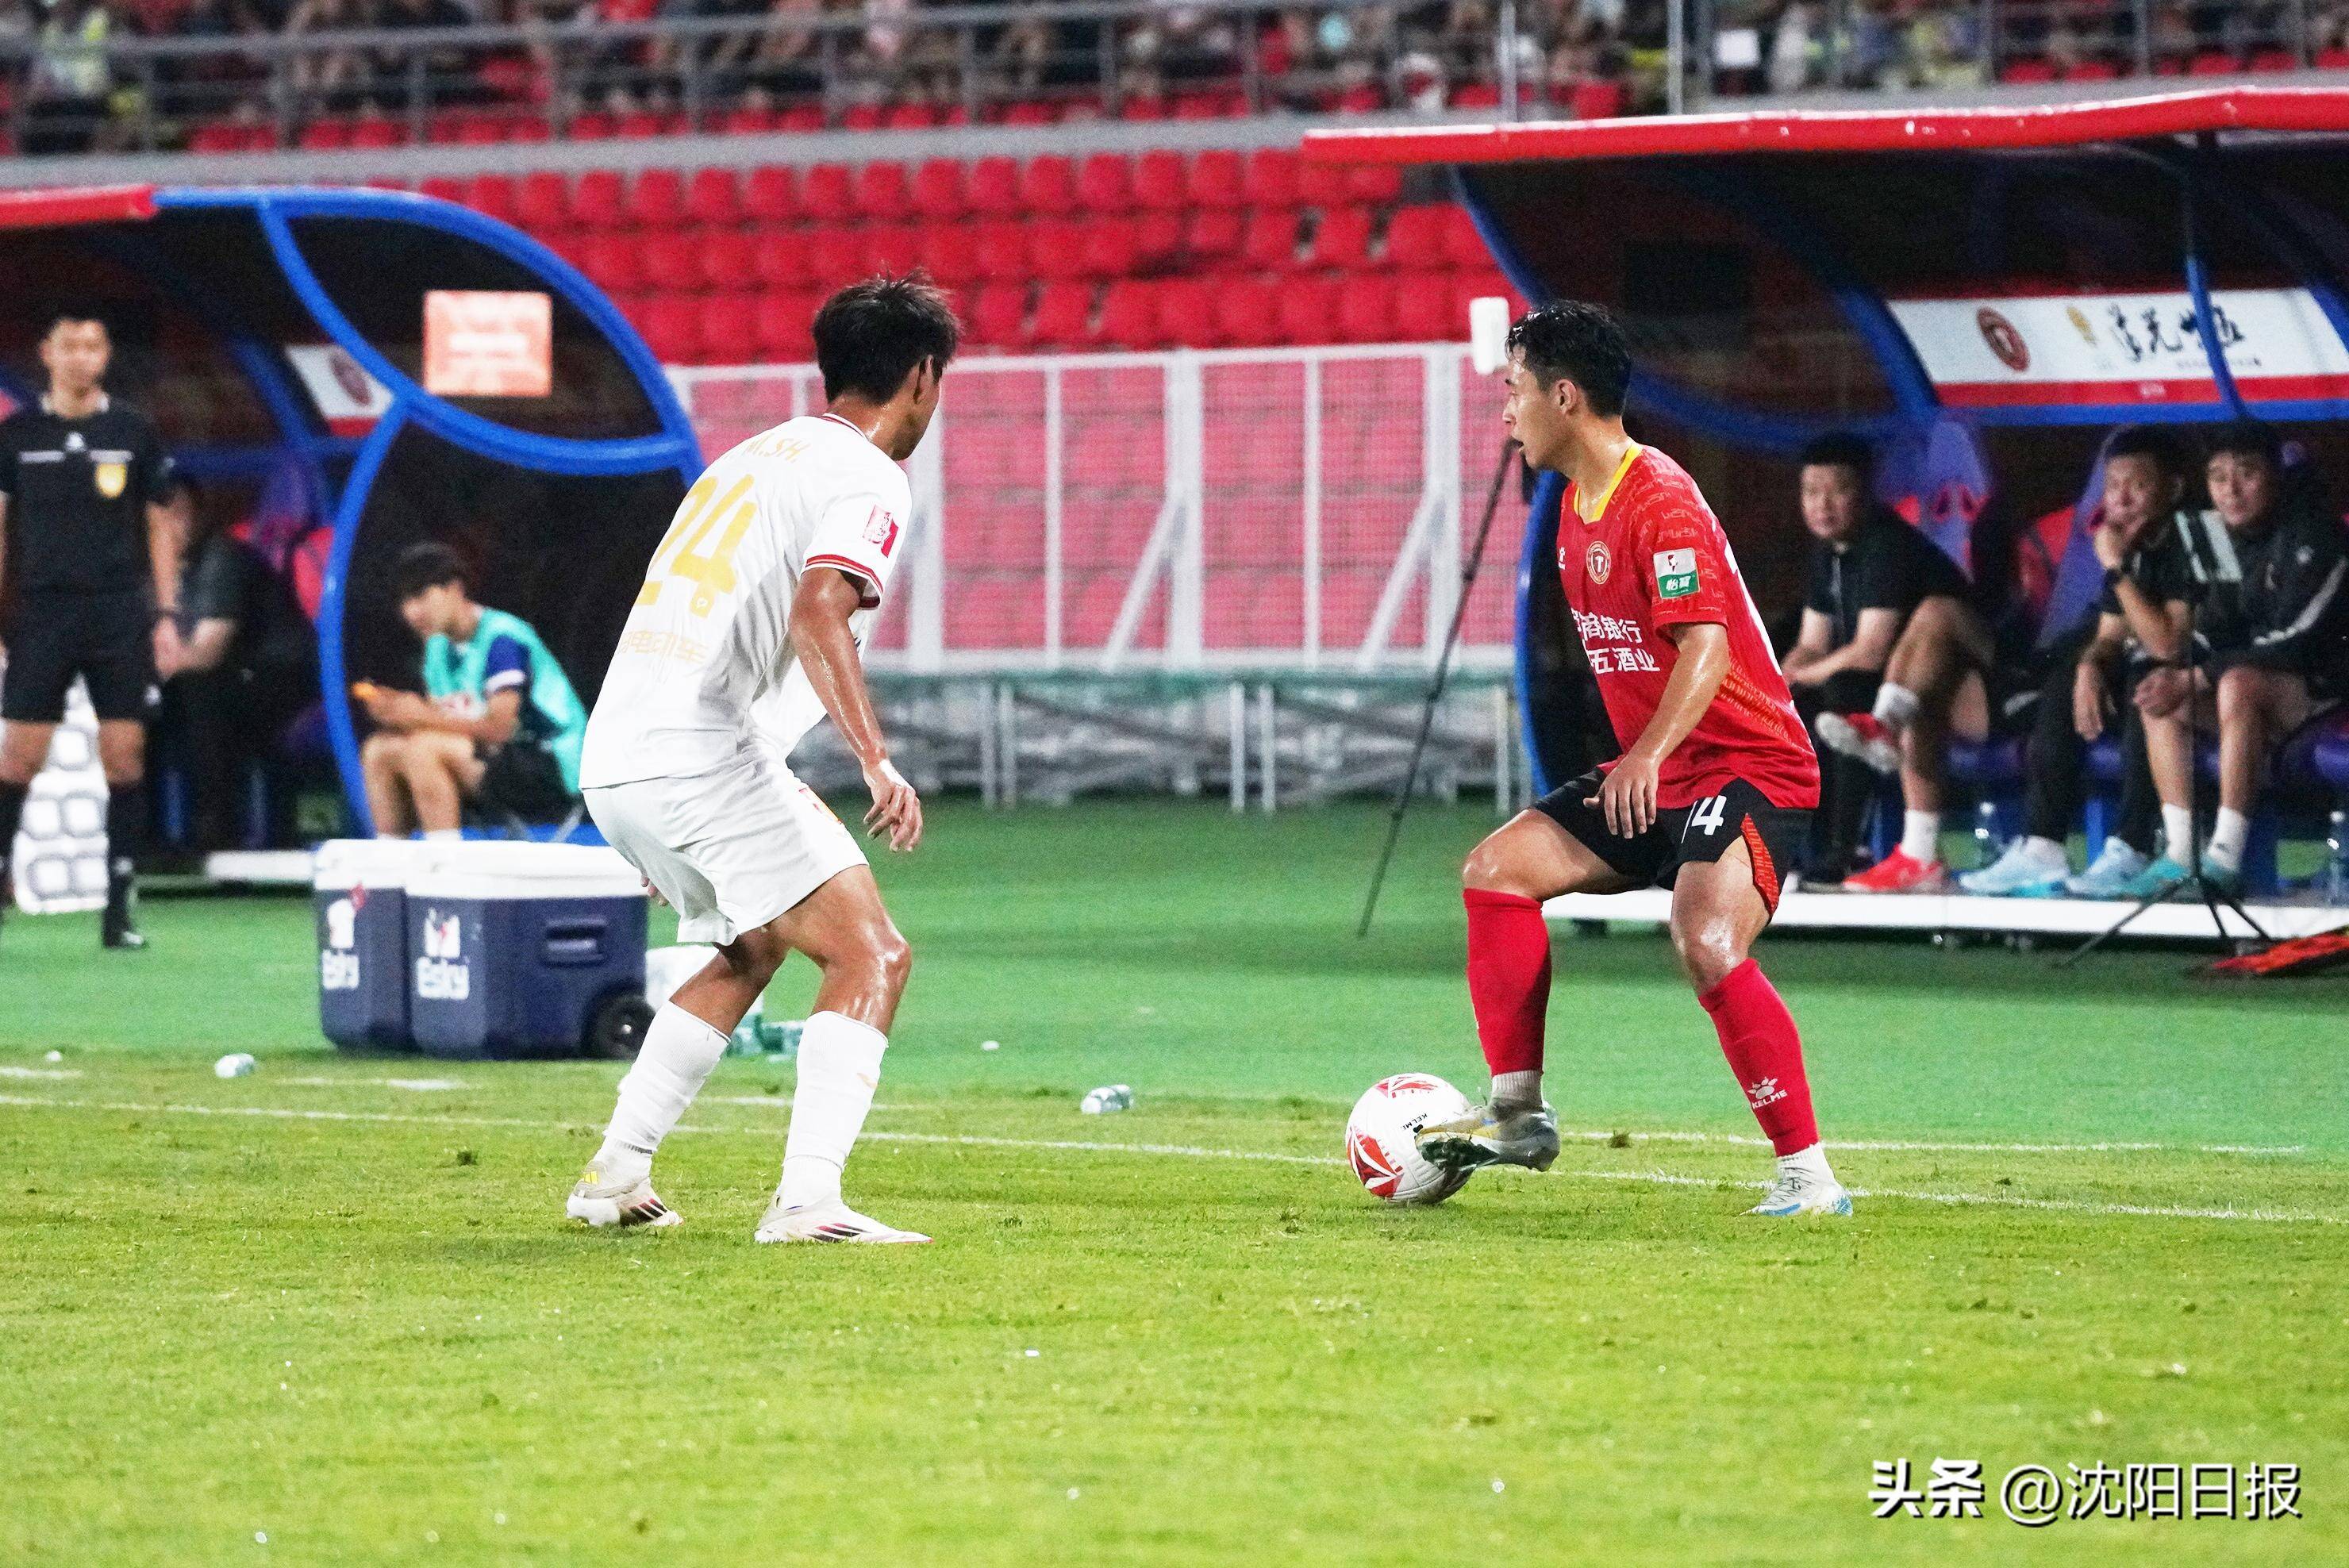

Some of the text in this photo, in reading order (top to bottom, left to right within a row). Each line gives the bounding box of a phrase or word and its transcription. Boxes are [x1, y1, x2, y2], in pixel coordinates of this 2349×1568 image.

[636, 475, 758, 619] 24
[1582, 639, 1660, 674] 五酒业
[1751, 1090, 1787, 1109] KELME
